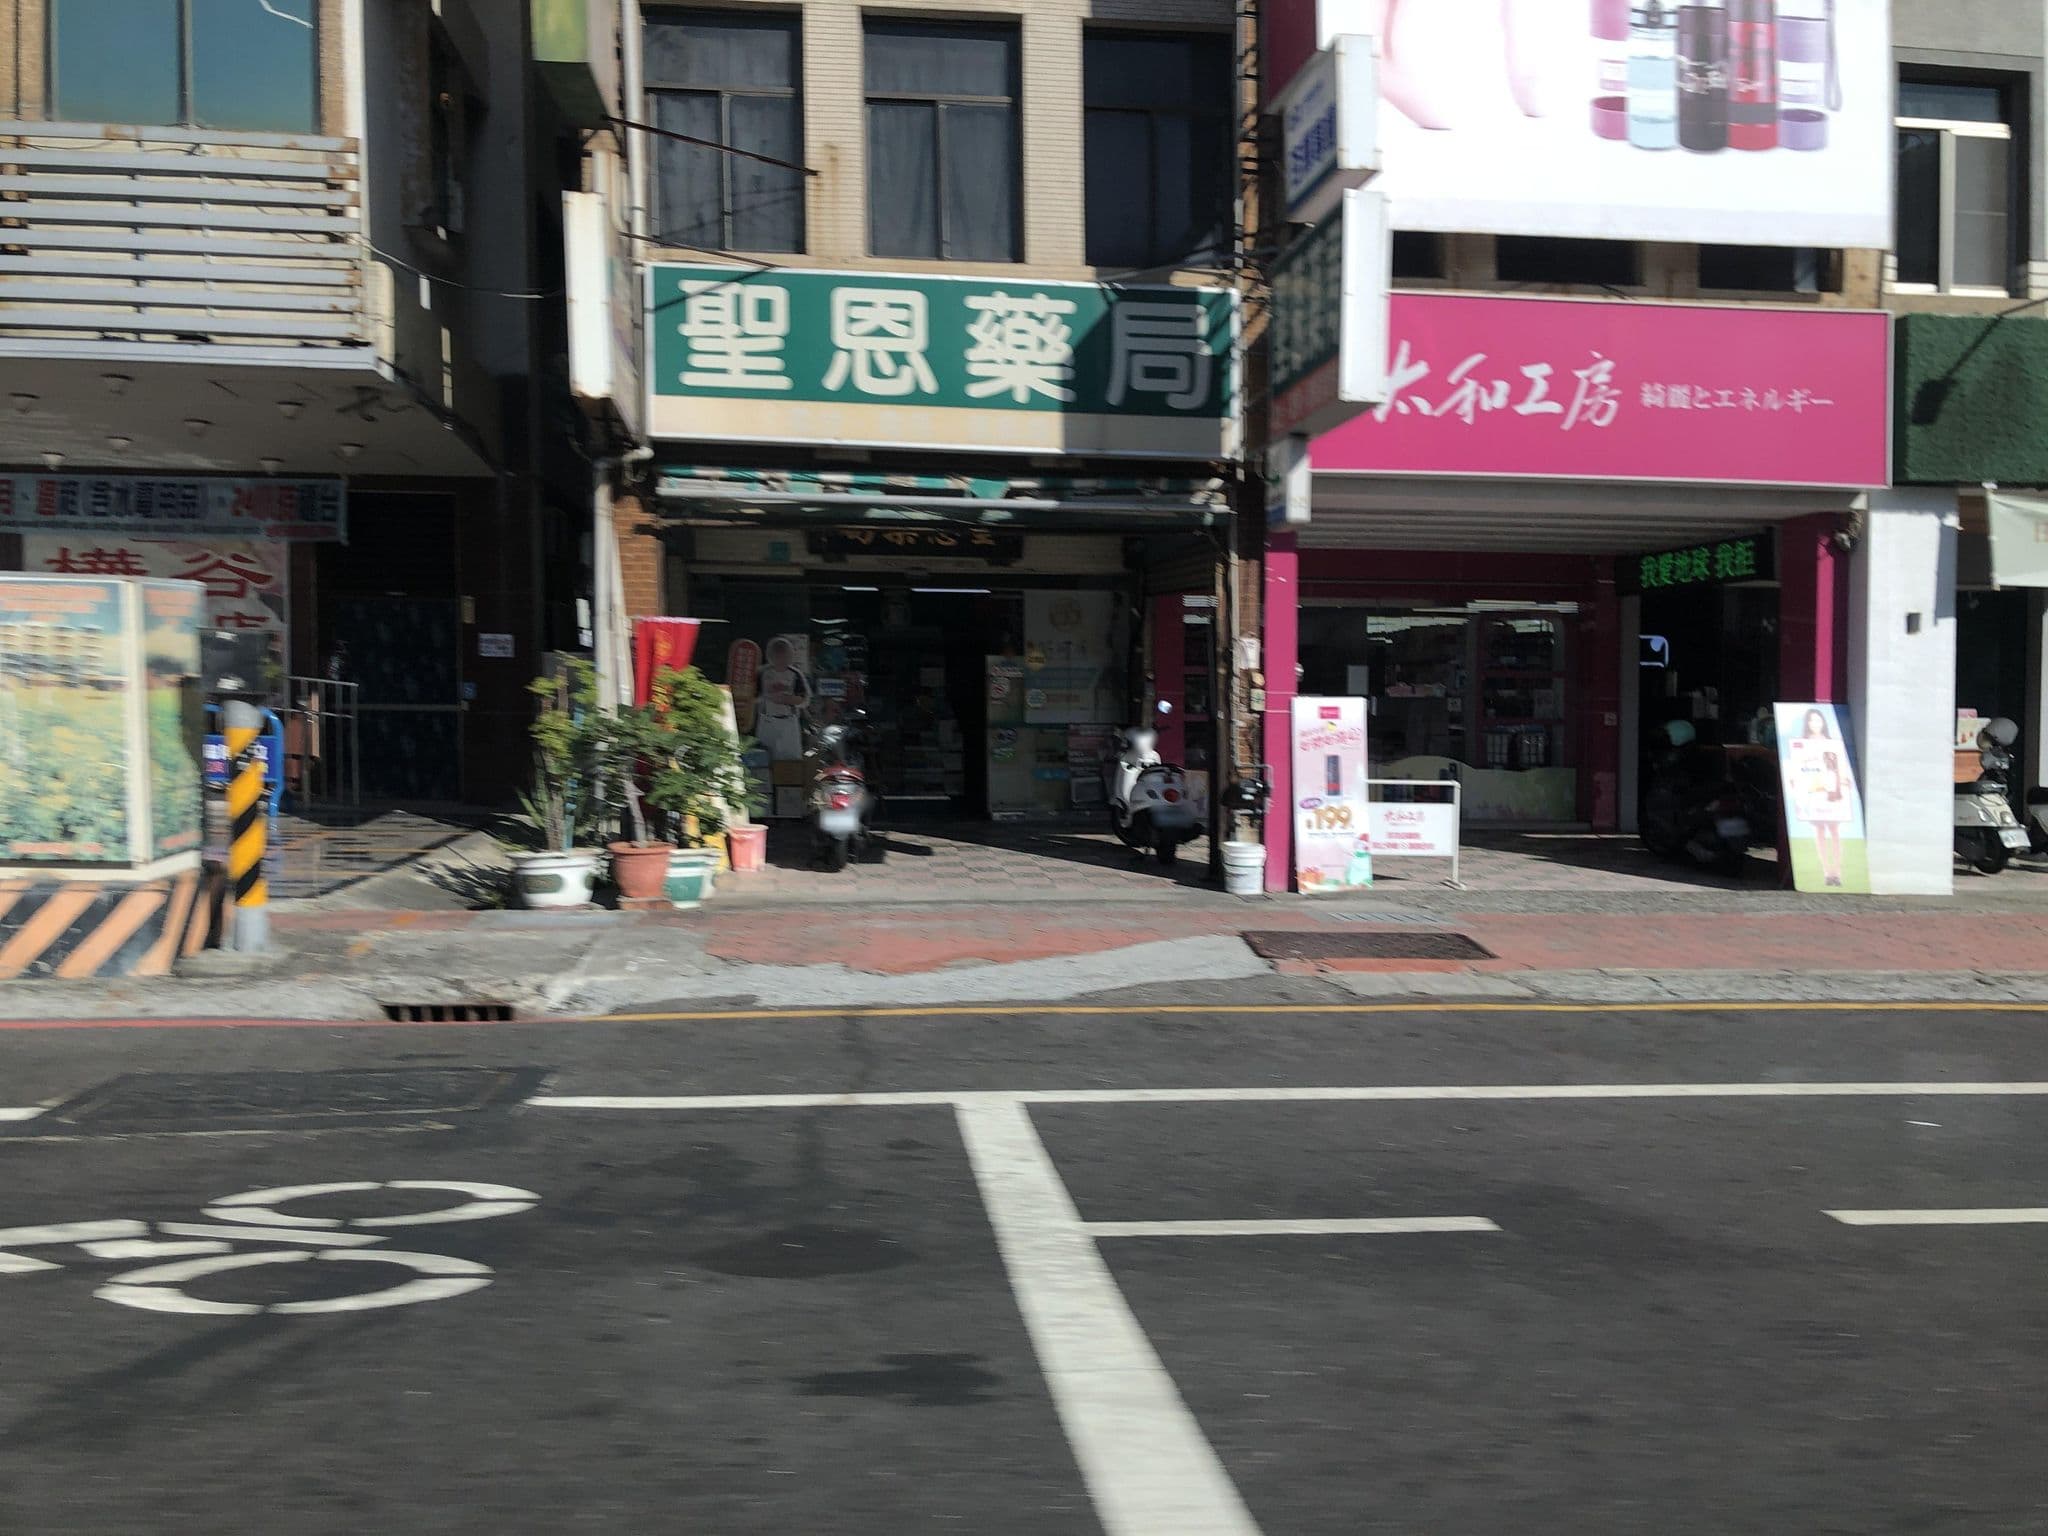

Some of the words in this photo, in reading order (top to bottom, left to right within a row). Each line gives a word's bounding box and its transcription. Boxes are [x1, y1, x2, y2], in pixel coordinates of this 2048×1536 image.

[677, 279, 1212, 411] 聖恩藥局
[1373, 340, 1622, 430] 太和工房
